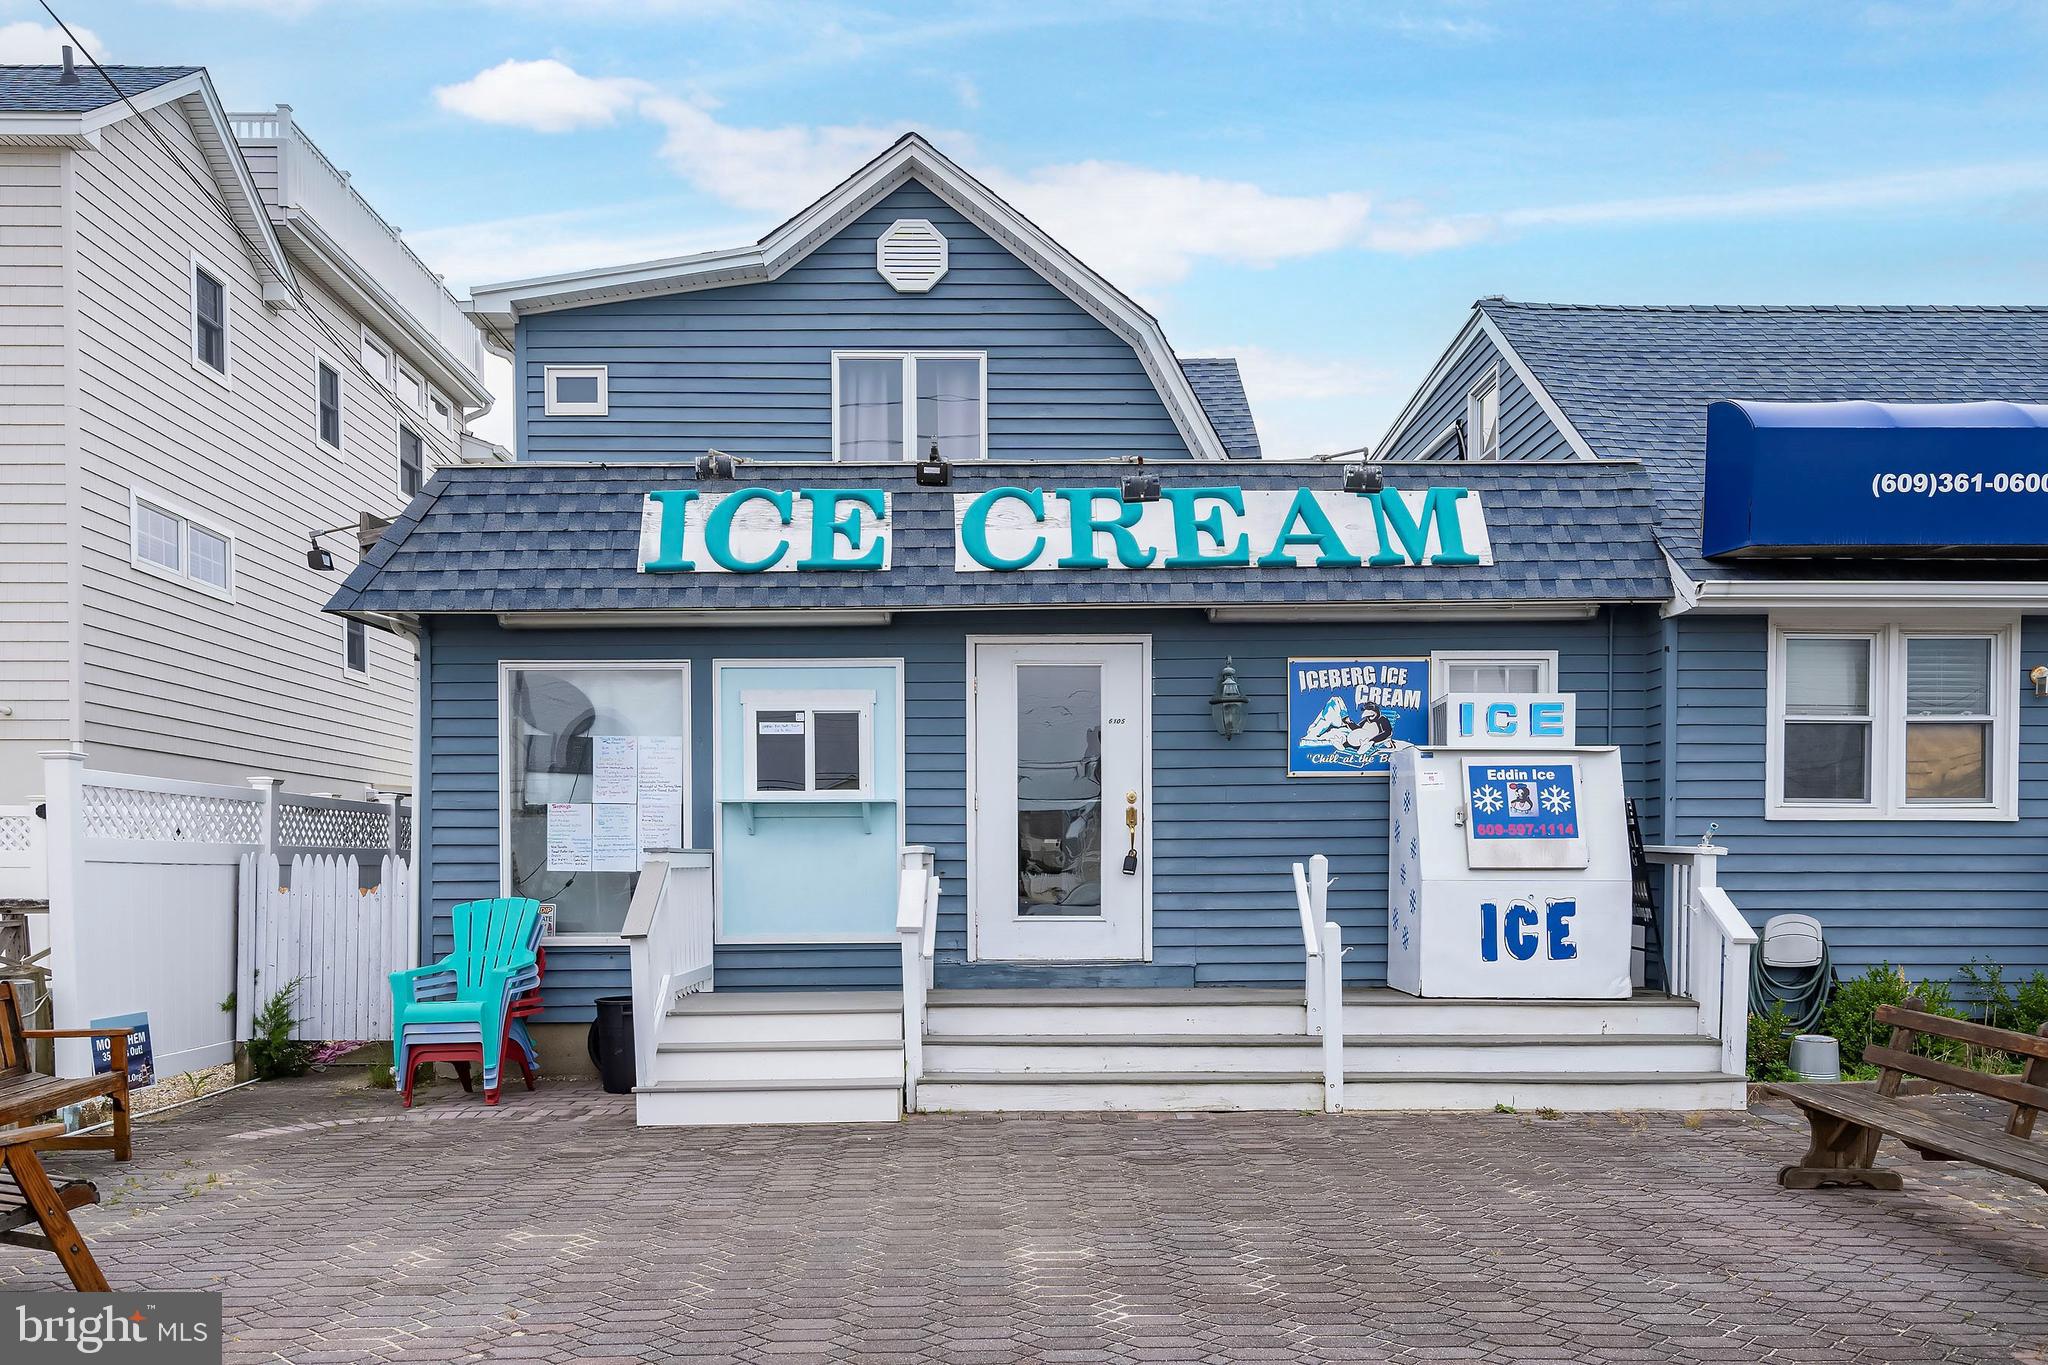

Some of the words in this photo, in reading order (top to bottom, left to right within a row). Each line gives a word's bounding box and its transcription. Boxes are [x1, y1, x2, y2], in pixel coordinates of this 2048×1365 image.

[644, 488, 887, 575] ICE
[961, 486, 1482, 572] CREAM
[1299, 666, 1377, 693] ICEBERG
[1380, 666, 1408, 686] ICE
[1355, 685, 1421, 711] CREAM
[1458, 702, 1564, 737] ICE
[1343, 755, 1355, 764] at
[1358, 754, 1375, 763] the
[1487, 769, 1528, 781] Eddin
[1532, 769, 1556, 781] Ice
[1477, 823, 1575, 836] 609-597-1114
[1480, 897, 1578, 962] ICE
[96, 1038, 110, 1051] MO
[127, 1031, 146, 1045] HEM
[102, 1052, 111, 1062] 35
[130, 1045, 143, 1056] Out!
